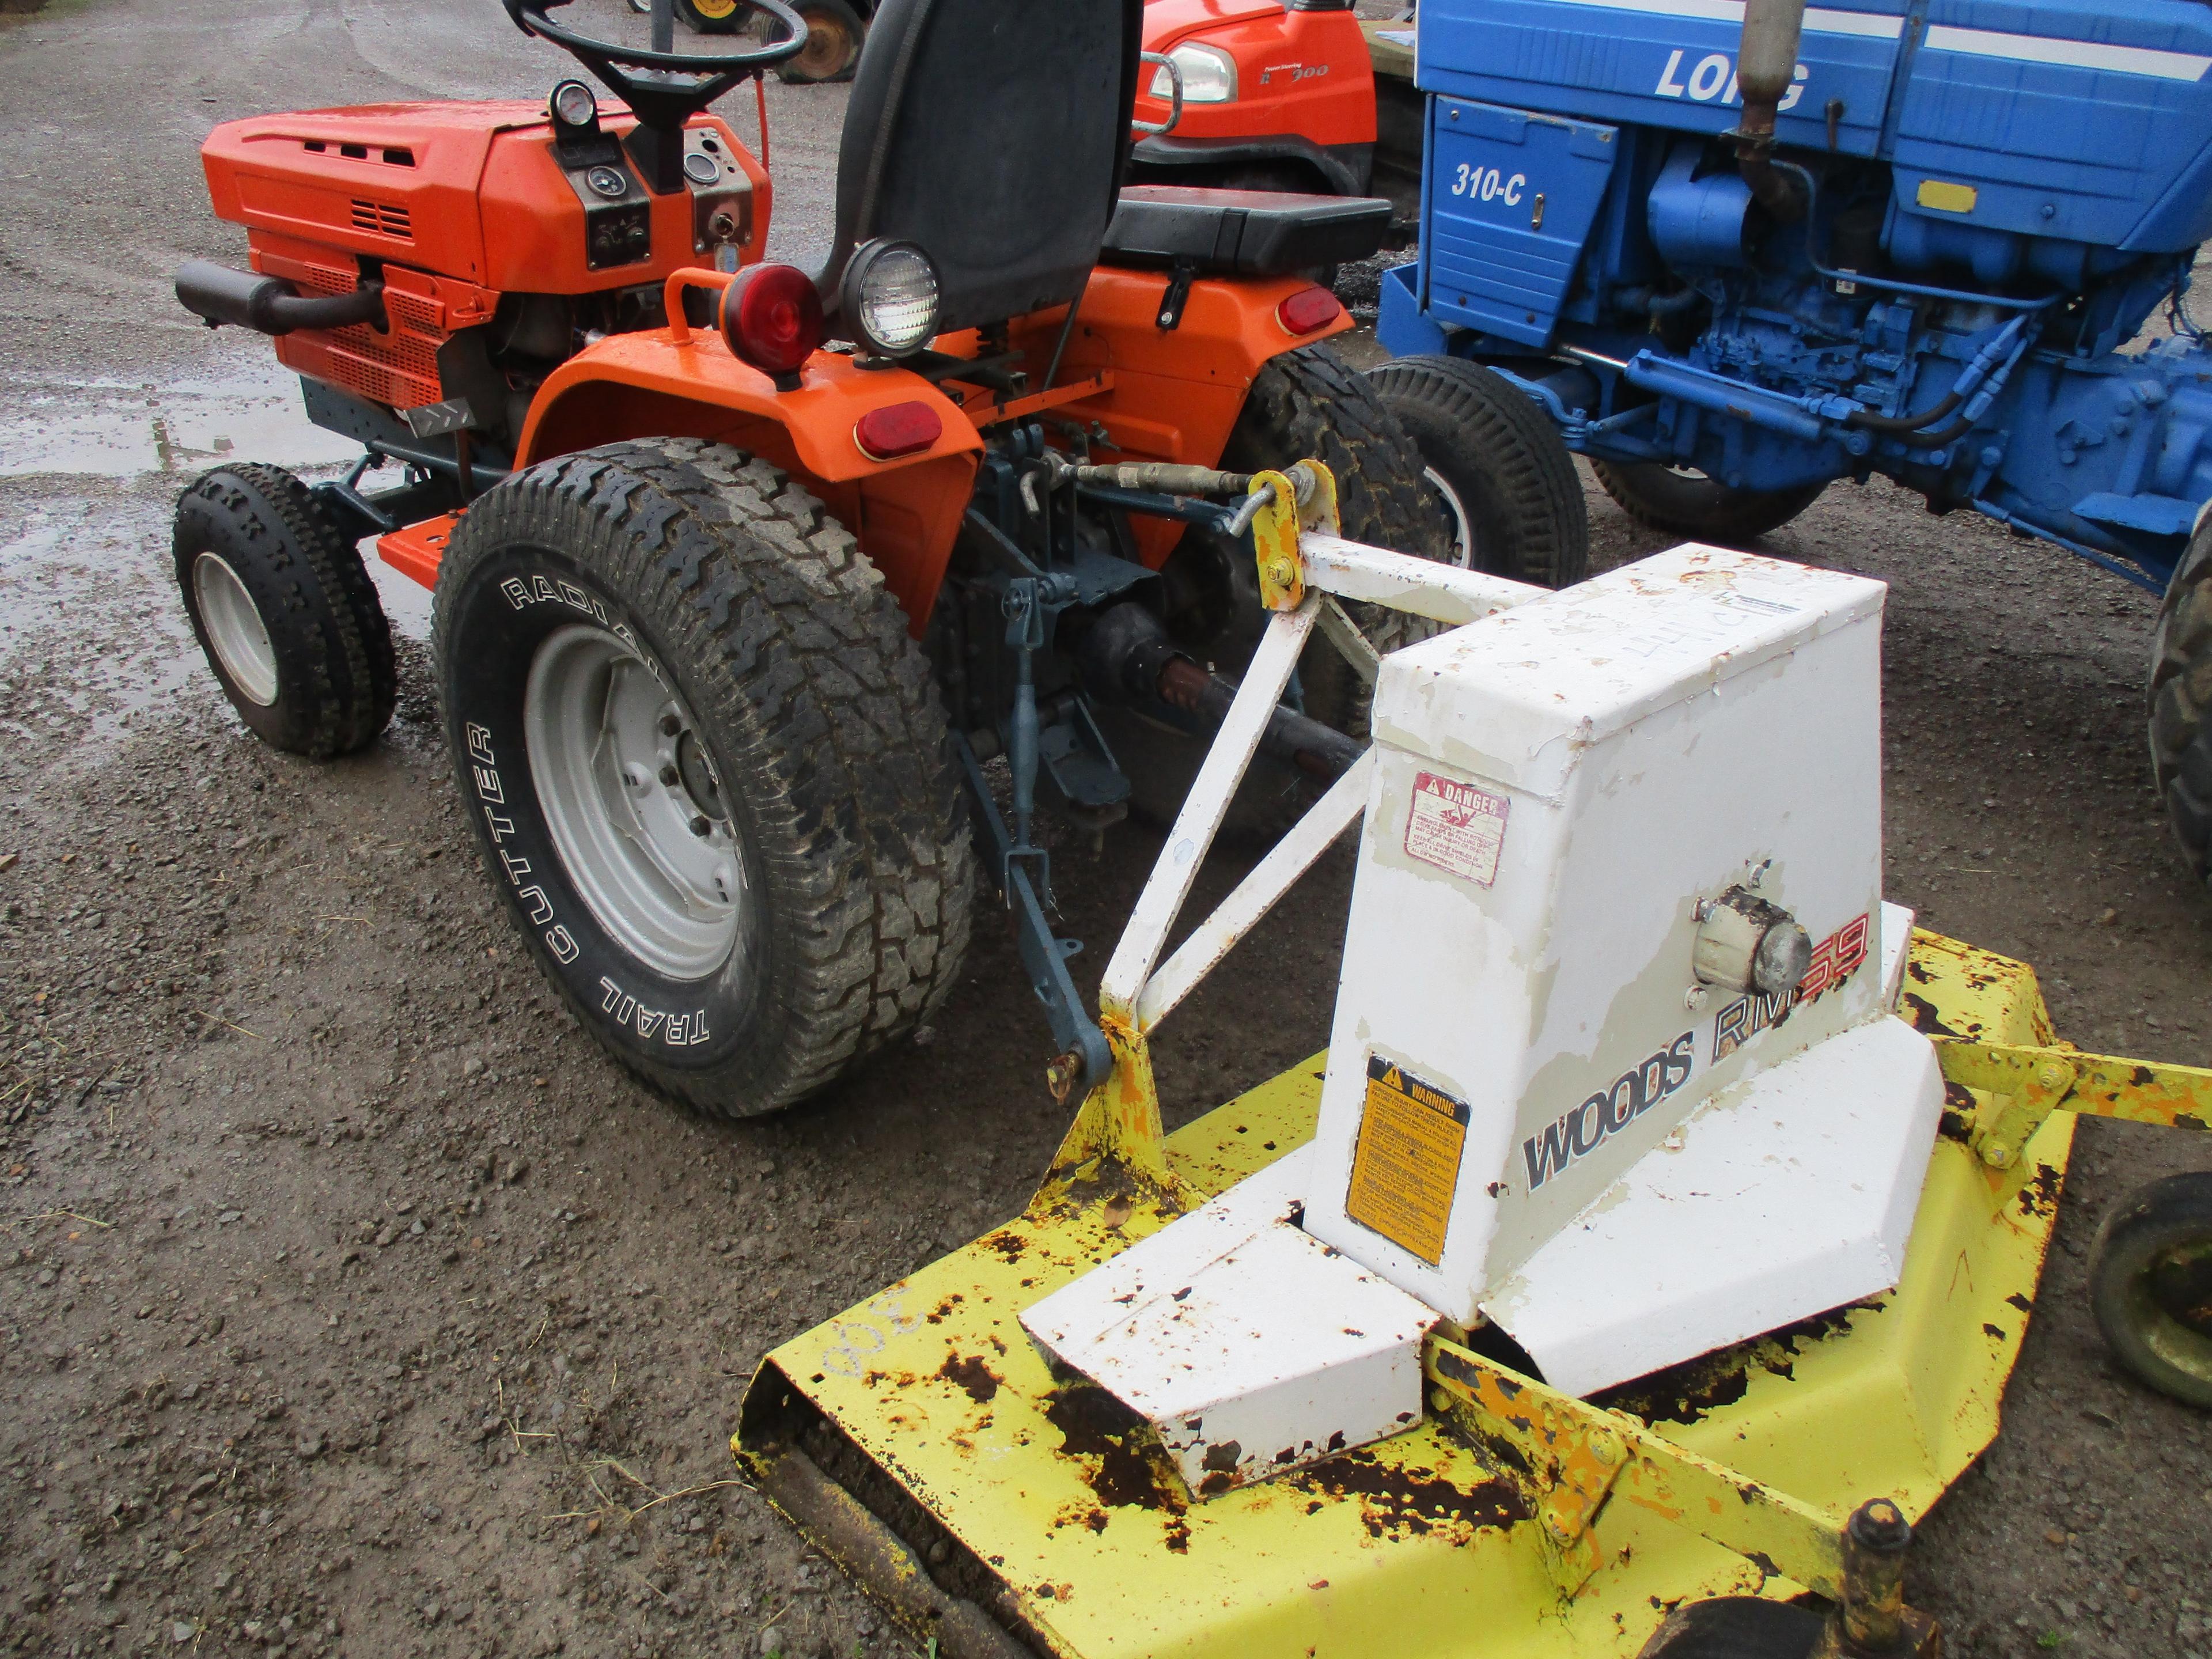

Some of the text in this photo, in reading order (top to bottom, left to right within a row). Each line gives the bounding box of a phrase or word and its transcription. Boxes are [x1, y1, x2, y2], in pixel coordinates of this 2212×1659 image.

[1291, 65, 1329, 83] 900
[1452, 163, 1525, 207] 310-C
[1445, 783, 1498, 815] DANGER
[467, 721, 581, 965] CUTTER
[1439, 849, 1454, 858] GOOD
[599, 975, 712, 1047] TRAIL
[1399, 1104, 1419, 1118] FOLLOW
[1411, 1083, 1456, 1118] WARNING
[1522, 1029, 1695, 1194] WOODS
